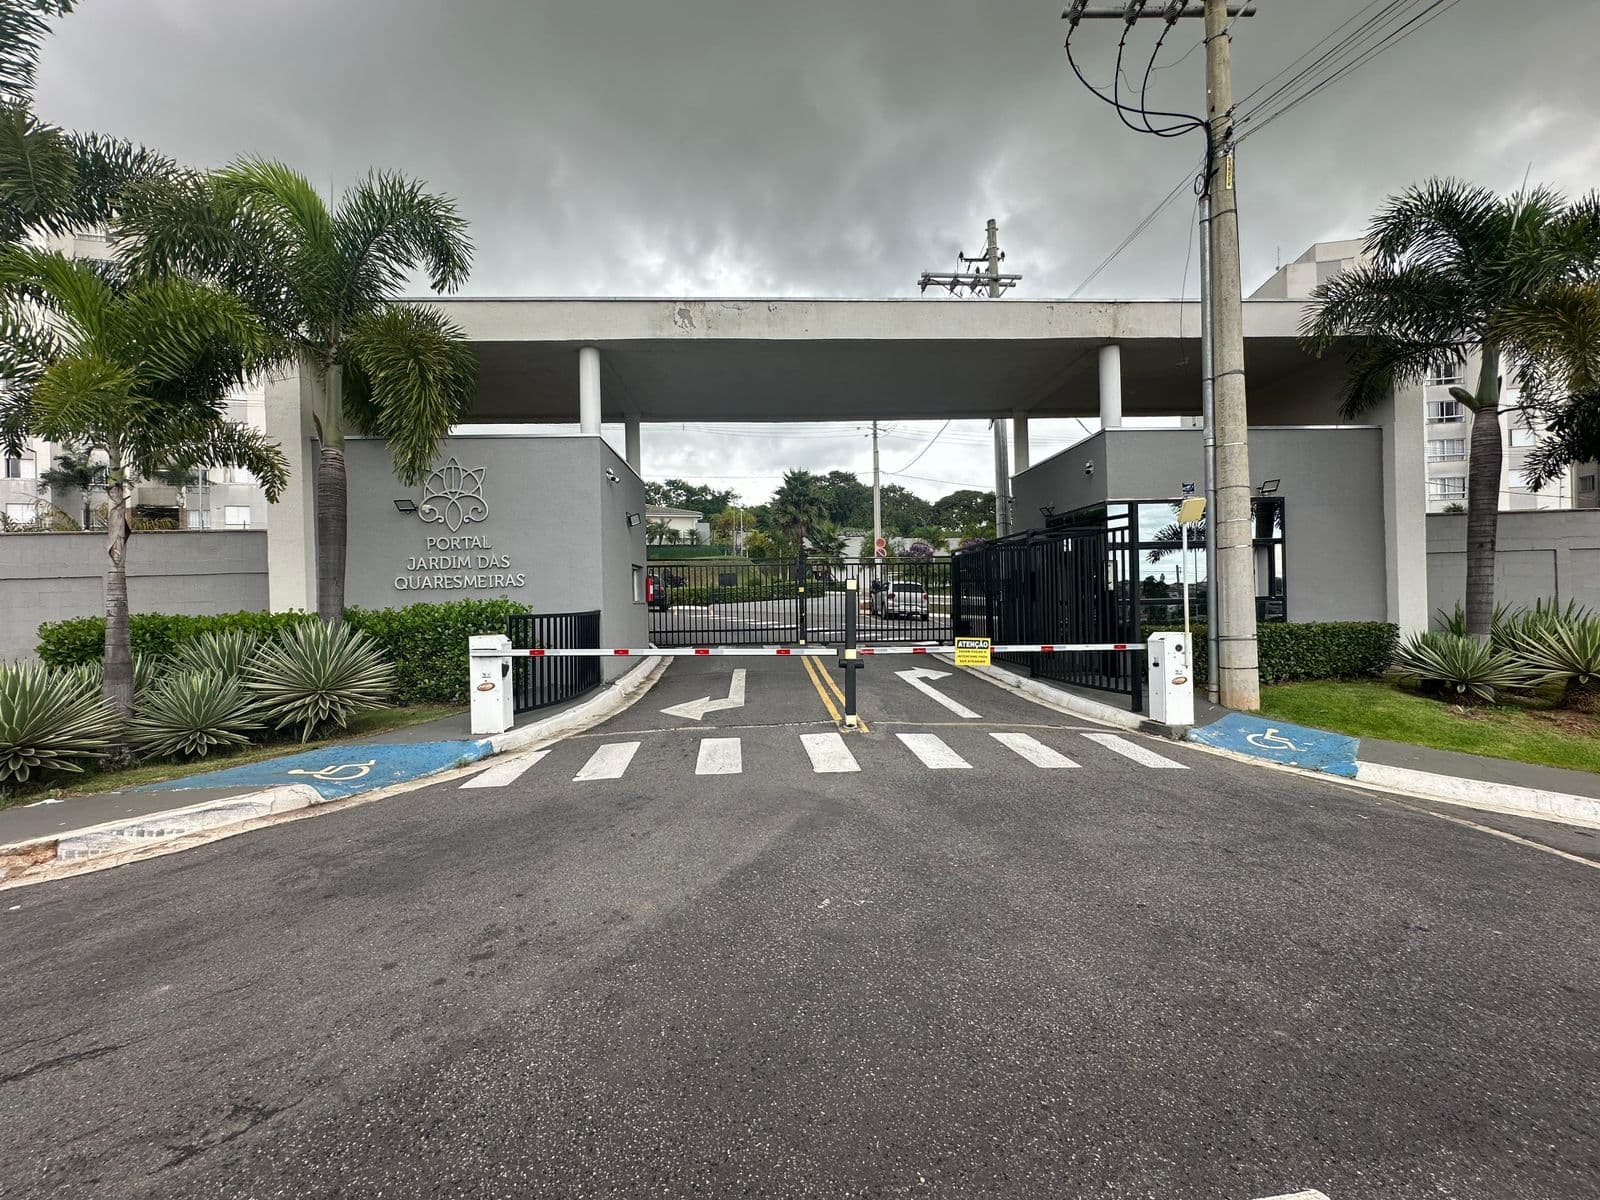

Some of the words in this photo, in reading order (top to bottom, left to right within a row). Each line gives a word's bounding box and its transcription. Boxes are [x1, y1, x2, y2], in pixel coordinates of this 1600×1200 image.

[426, 535, 492, 550] PORTAL
[407, 555, 472, 570] JARDIM
[477, 554, 511, 569] DAS
[394, 573, 526, 590] QUARESMEIRAS
